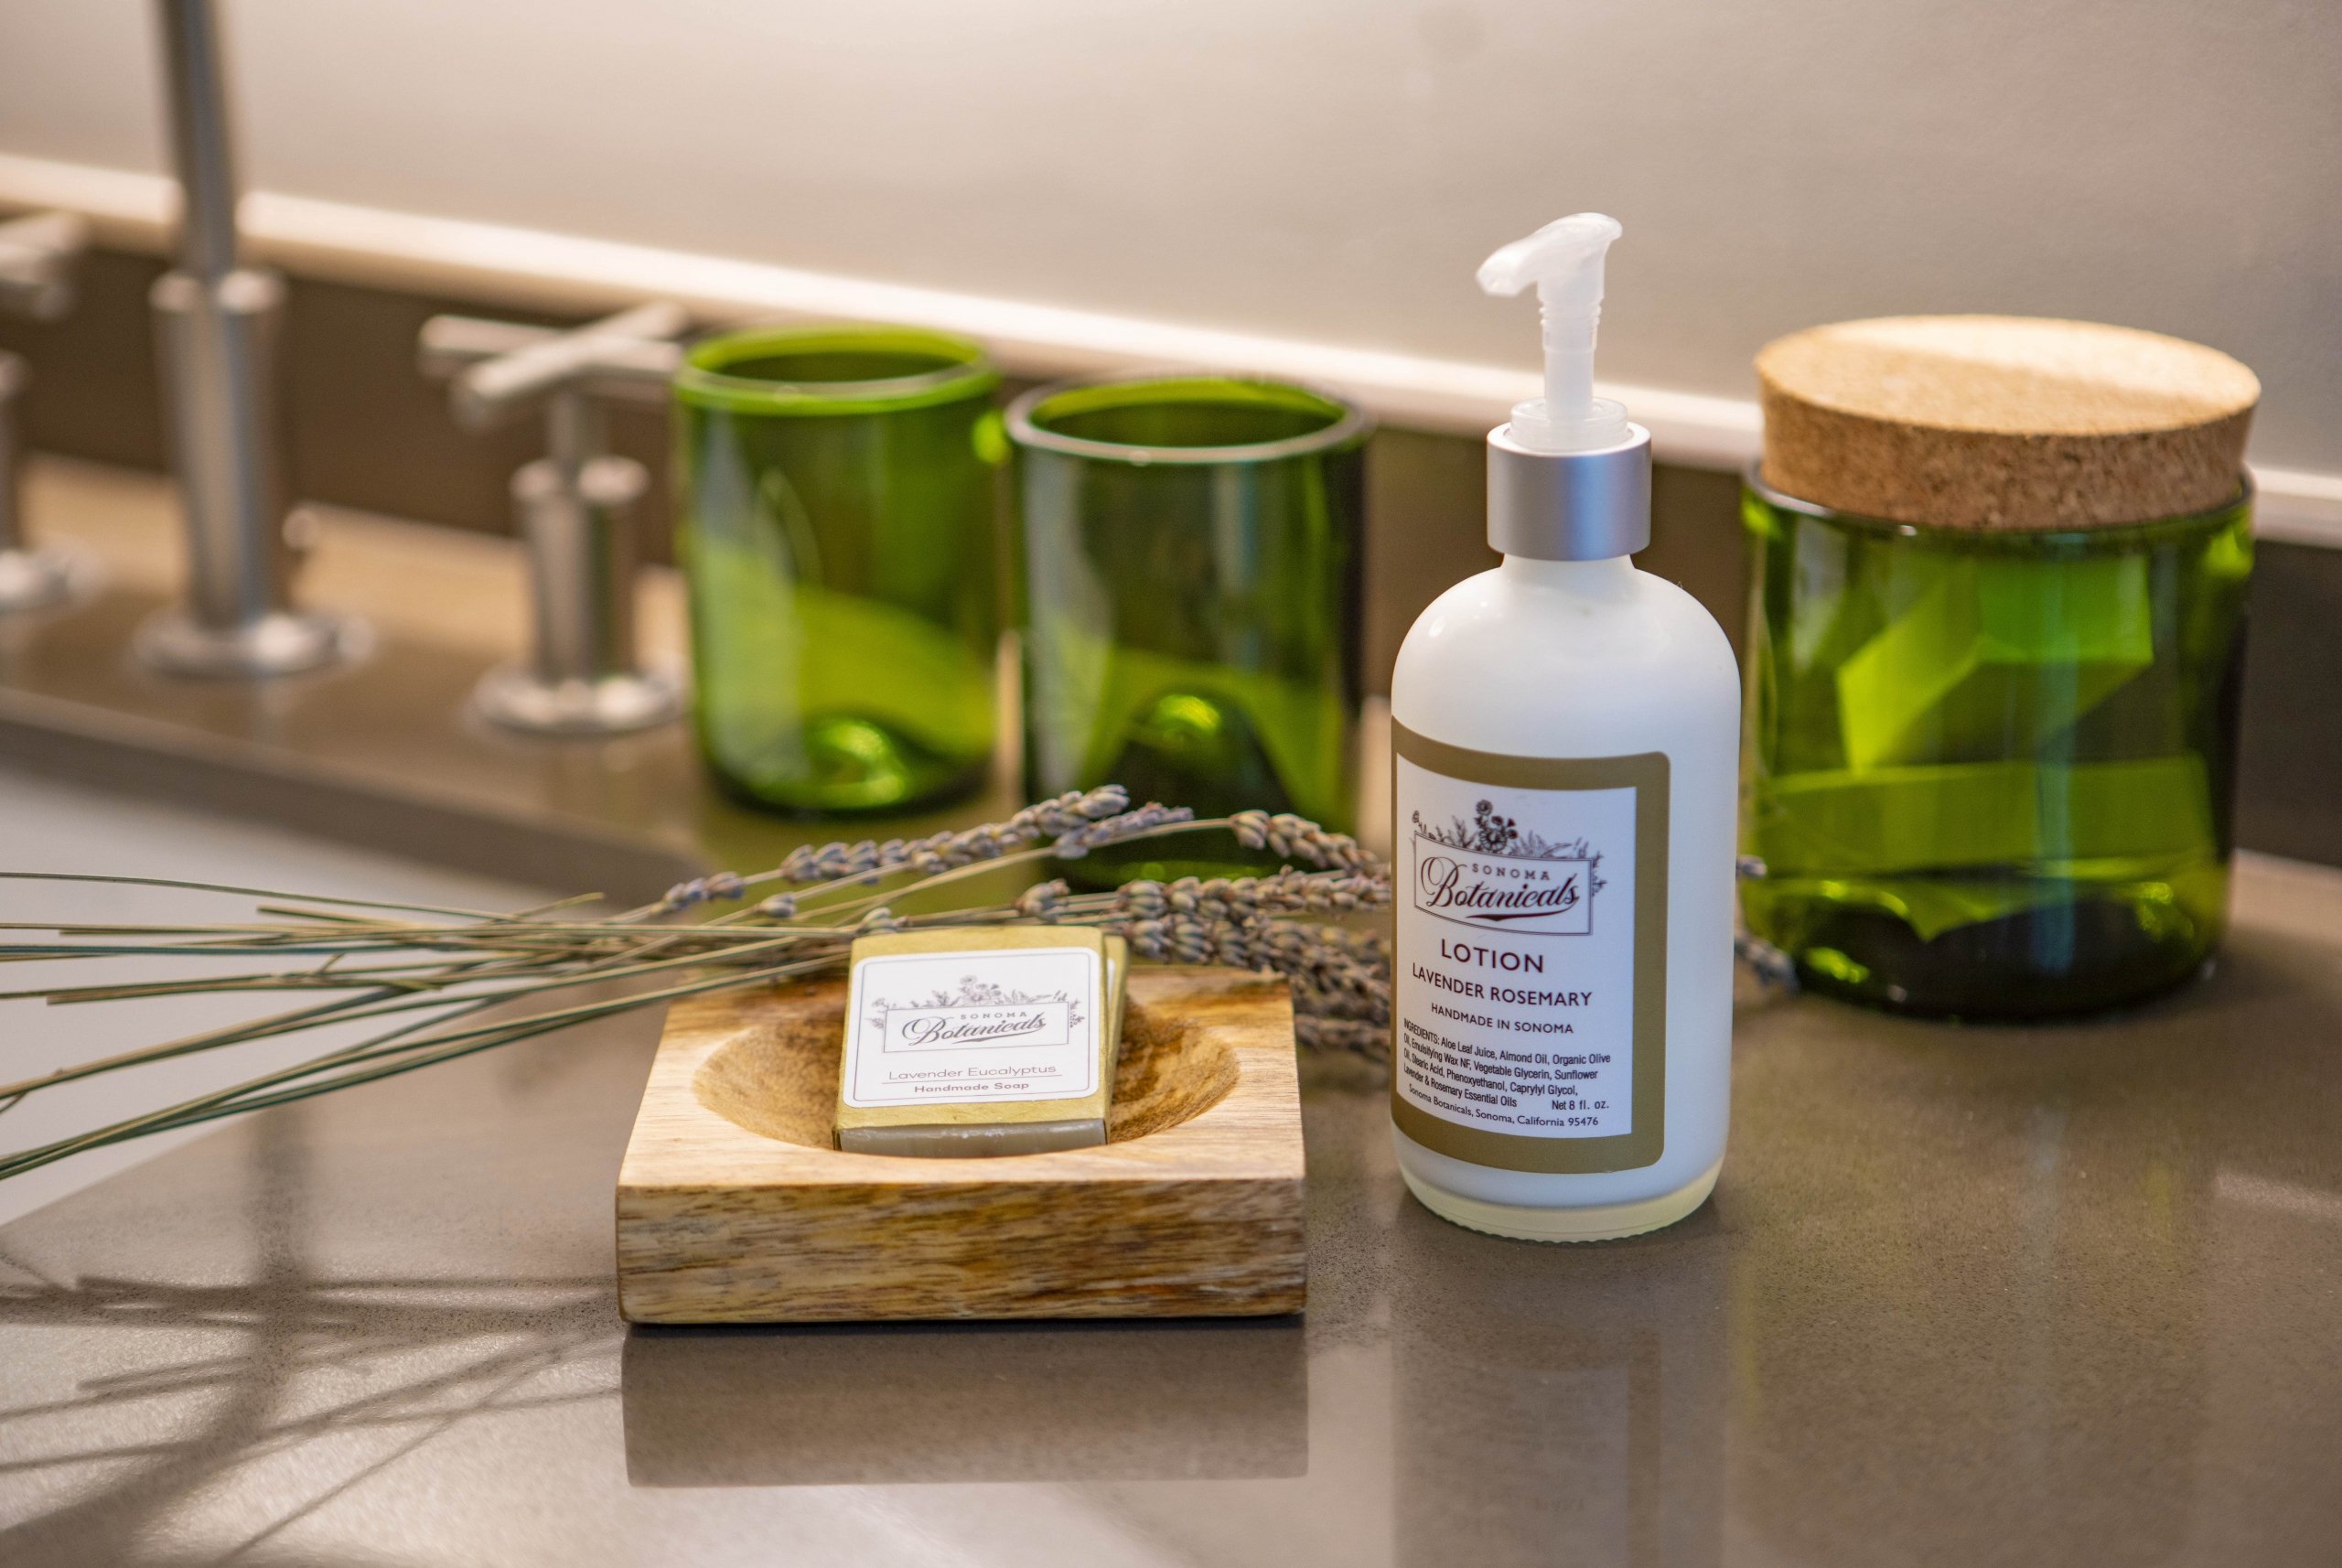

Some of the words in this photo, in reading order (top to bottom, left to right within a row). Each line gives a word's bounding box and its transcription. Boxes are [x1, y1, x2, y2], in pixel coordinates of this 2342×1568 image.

[1420, 856, 1580, 921] Botanicals
[1472, 863, 1551, 881] SONOMA
[1441, 939, 1543, 973] LOTION
[1413, 962, 1485, 999] LAVENDER
[1490, 986, 1593, 1006] ROSEMARY
[901, 1012, 1046, 1046] Botanicals
[960, 1011, 1028, 1020] SONOMA
[1431, 1003, 1493, 1028] HANDMADE
[1497, 1019, 1510, 1030] IN
[1514, 1021, 1574, 1034] SONOMA
[1403, 1017, 1440, 1045] INGREDIENTS:
[1441, 1037, 1456, 1050] Aloe
[1457, 1041, 1473, 1054] Leaf
[1474, 1046, 1497, 1060] Juice,
[1499, 1050, 1532, 1063] Almond
[1535, 1053, 1550, 1065] Oil,
[1552, 1054, 1586, 1066] Organic
[1589, 1053, 1611, 1064] Olive
[888, 1069, 962, 1080] Lavender
[968, 1065, 1057, 1079] Eucalyptus
[1412, 1053, 1428, 1070] Stearic
[1429, 1063, 1445, 1078] Acid,
[1446, 1069, 1508, 1092] Phenoxyethanol,
[1509, 1081, 1545, 1096] Caprylyl
[1547, 1084, 1578, 1097] Glycol,
[1444, 1052, 1458, 1066] Wax
[1460, 1058, 1472, 1070] NF,
[1474, 1060, 1511, 1077] Vegetable
[1514, 1067, 1552, 1080] Glycerin,
[1554, 1069, 1598, 1079] Sunflower
[914, 1082, 989, 1093] Handmade
[994, 1081, 1029, 1091] Soap
[1403, 1063, 1423, 1083] Lavender
[1424, 1076, 1430, 1086] &
[1431, 1078, 1463, 1099] Rosemary
[1464, 1089, 1498, 1105] Essential
[1500, 1096, 1518, 1108] Oils
[1409, 1083, 1432, 1103] Sonoma
[1434, 1096, 1474, 1117] Botanicals,
[1476, 1109, 1515, 1124] Sonoma,
[1517, 1115, 1564, 1127] California
[1568, 1117, 1598, 1126] 95476
[1552, 1100, 1566, 1111] Net
[1569, 1101, 1575, 1111] 8
[1579, 1100, 1590, 1110] fl.
[1595, 1101, 1609, 1110] oz.
